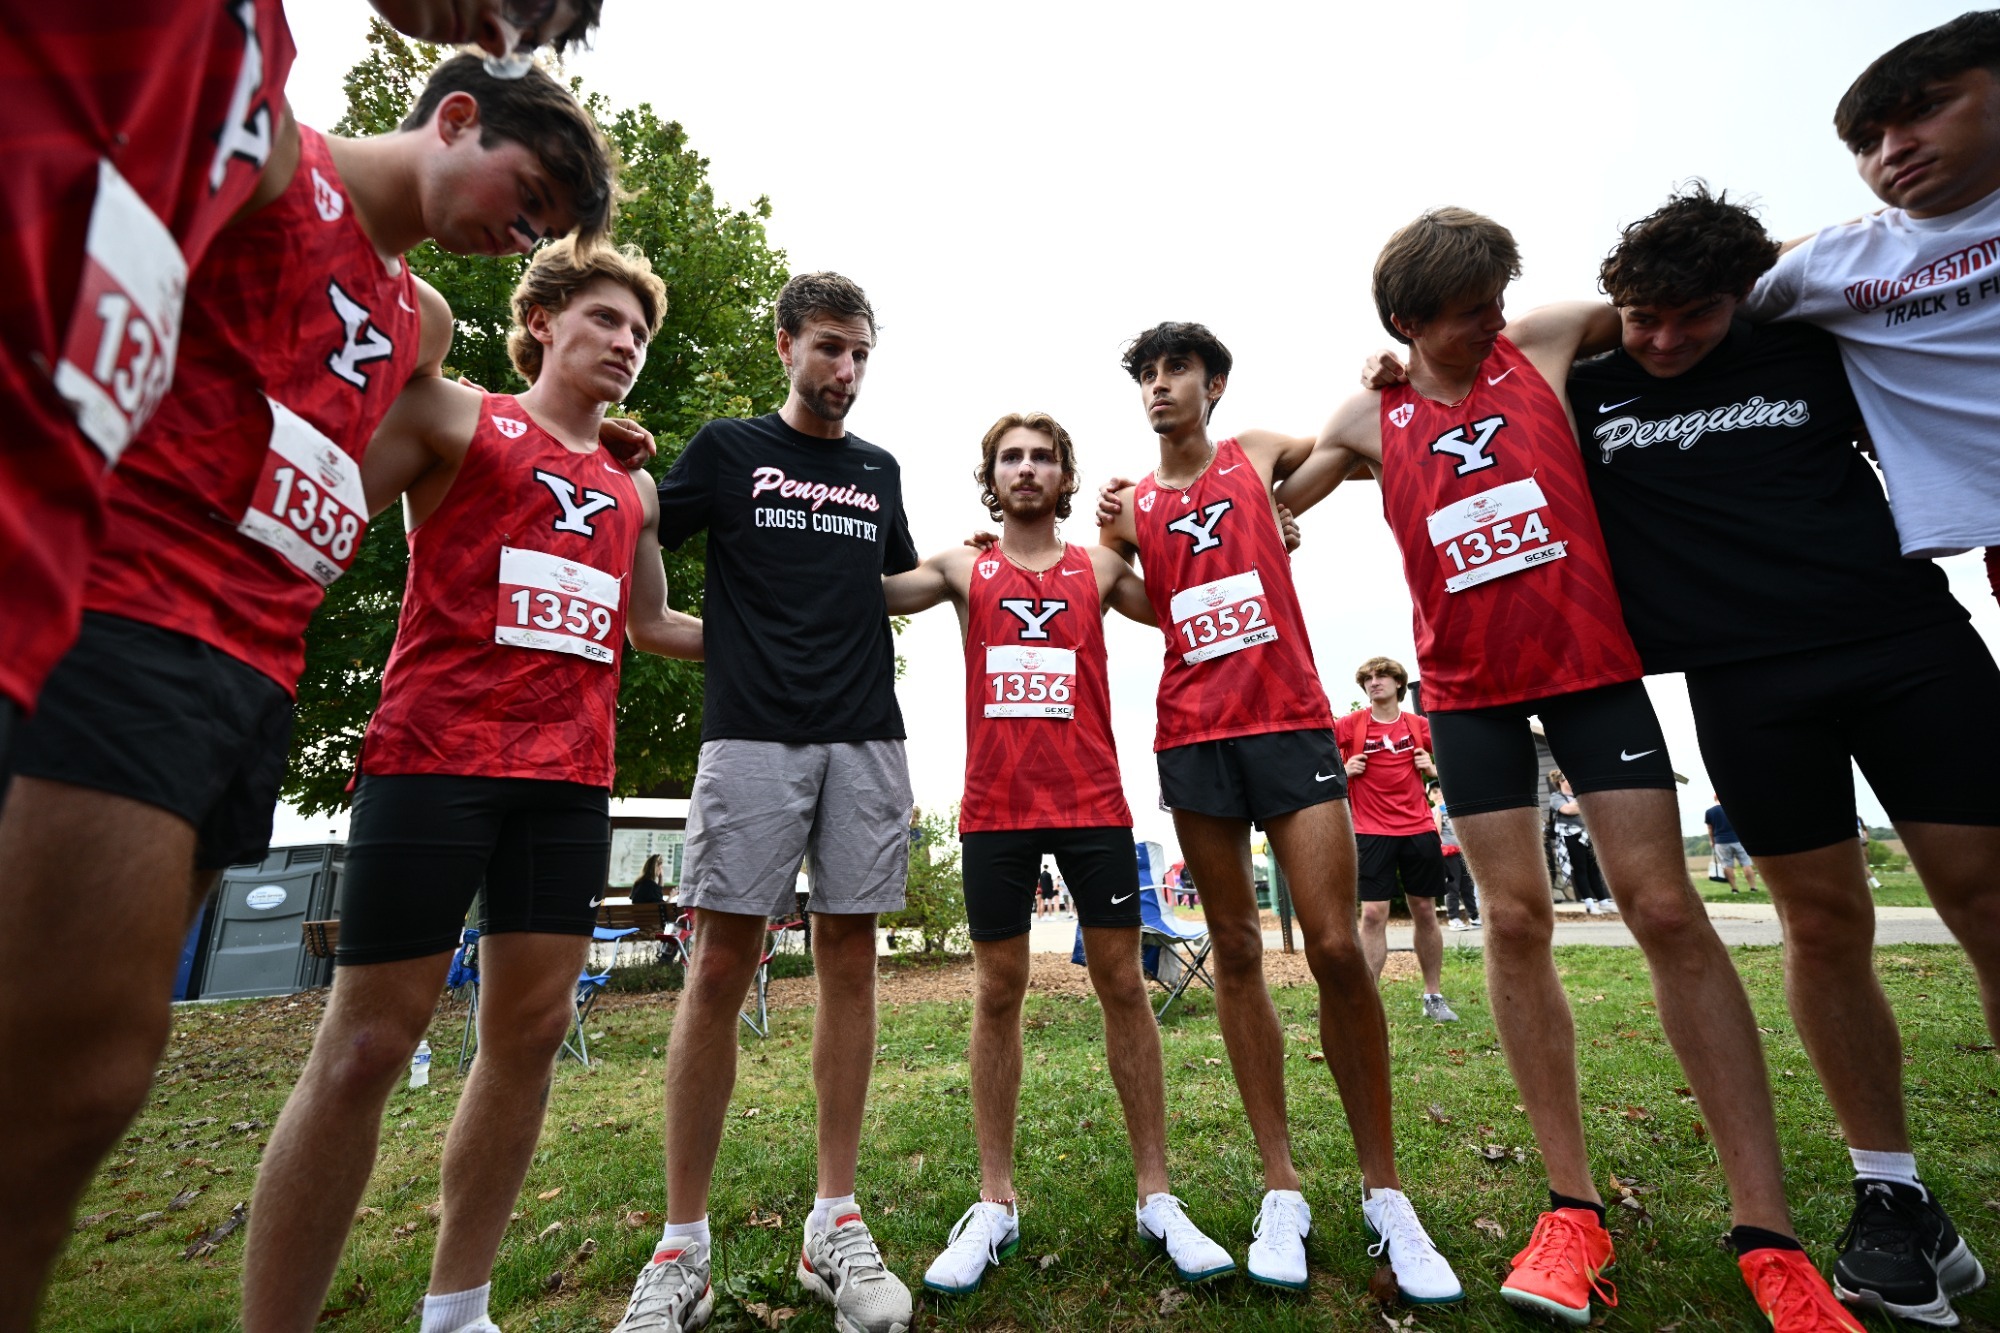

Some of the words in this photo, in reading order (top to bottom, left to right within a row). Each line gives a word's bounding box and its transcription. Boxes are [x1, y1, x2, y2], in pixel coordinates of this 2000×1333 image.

[1886, 294, 1947, 328] TRACK
[1956, 287, 1971, 306] &
[1979, 276, 2000, 299] FI
[324, 275, 395, 395] Y
[1428, 414, 1508, 479] Y
[1593, 396, 1809, 464] Penguins
[271, 467, 359, 561] 1358
[533, 467, 618, 541] Y
[752, 466, 880, 511] Penguins
[755, 507, 807, 530] CROSS
[812, 513, 878, 542] COUNTRY
[1166, 498, 1234, 557] Y
[1445, 511, 1551, 572] 1354
[1524, 548, 1557, 563] GCXC
[511, 588, 612, 641] 1359
[999, 598, 1069, 641] Y
[1181, 600, 1267, 649] 1352
[992, 673, 1071, 702] 1356
